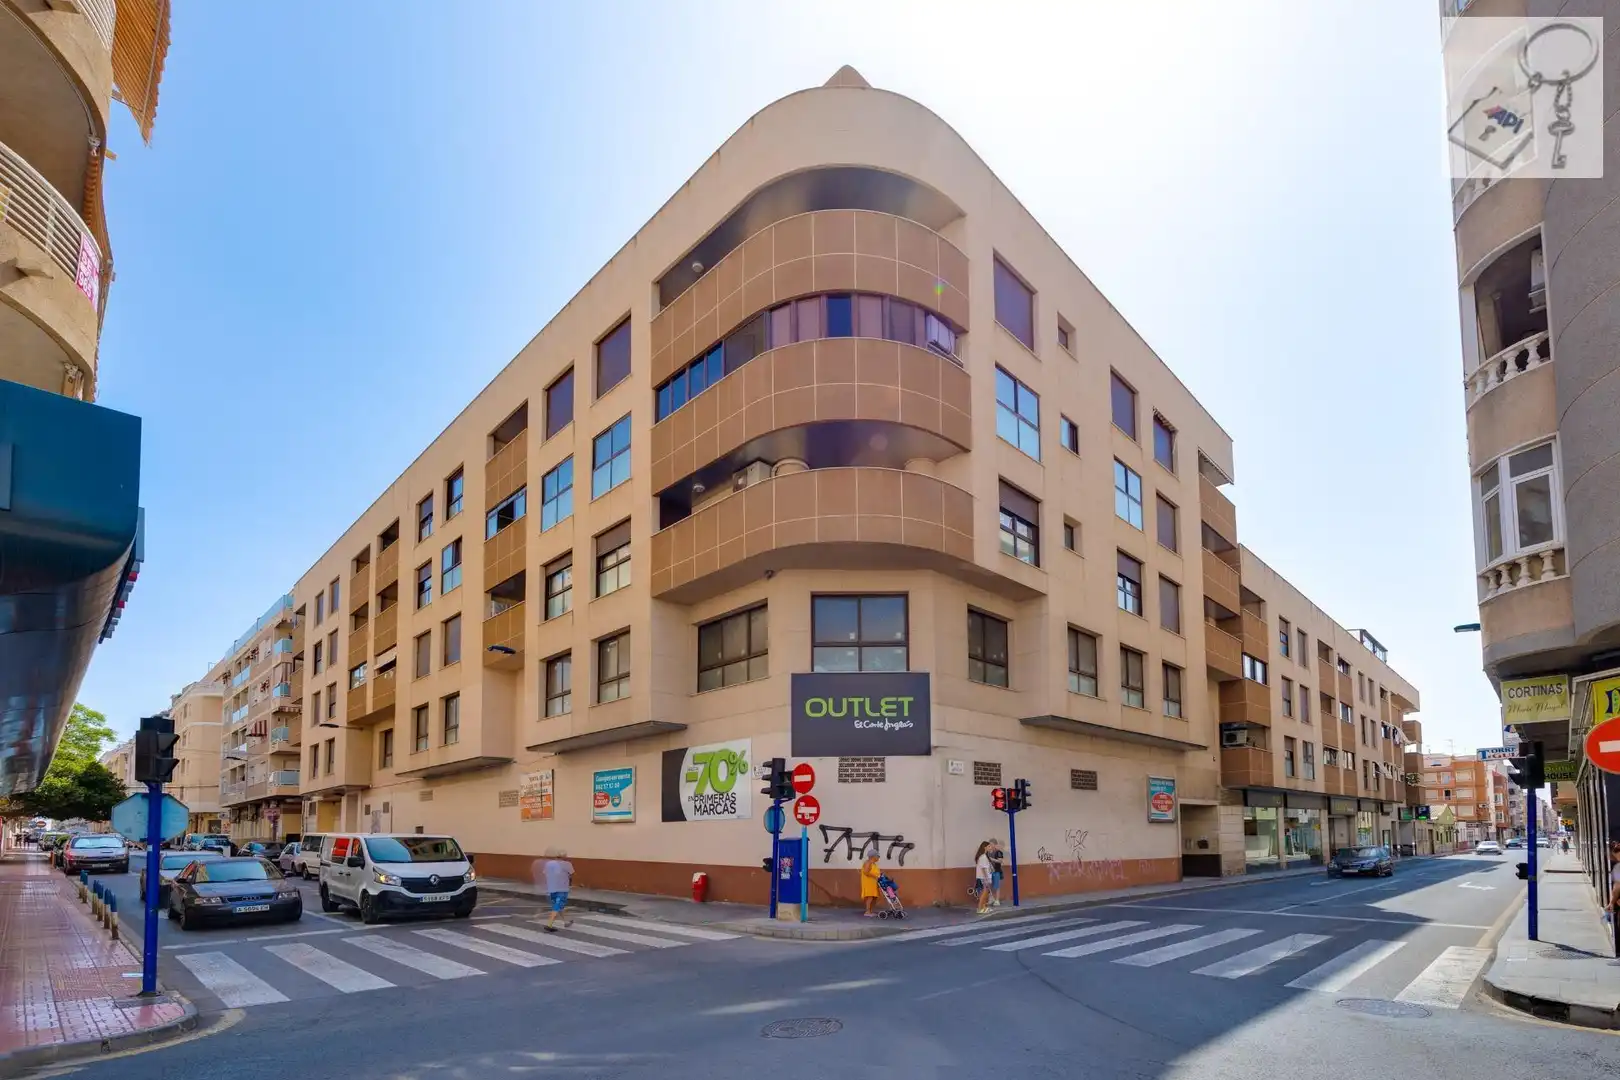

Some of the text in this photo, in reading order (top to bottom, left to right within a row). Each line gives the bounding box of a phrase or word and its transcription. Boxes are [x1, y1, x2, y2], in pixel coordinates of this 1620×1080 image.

[1508, 683, 1563, 699] CORTINAS
[805, 697, 914, 717] OUTLET
[853, 717, 914, 731] El Corte Inglés
[686, 748, 749, 795] -70%
[694, 792, 737, 804] PRIMERAS
[694, 802, 737, 816] MARCAS
